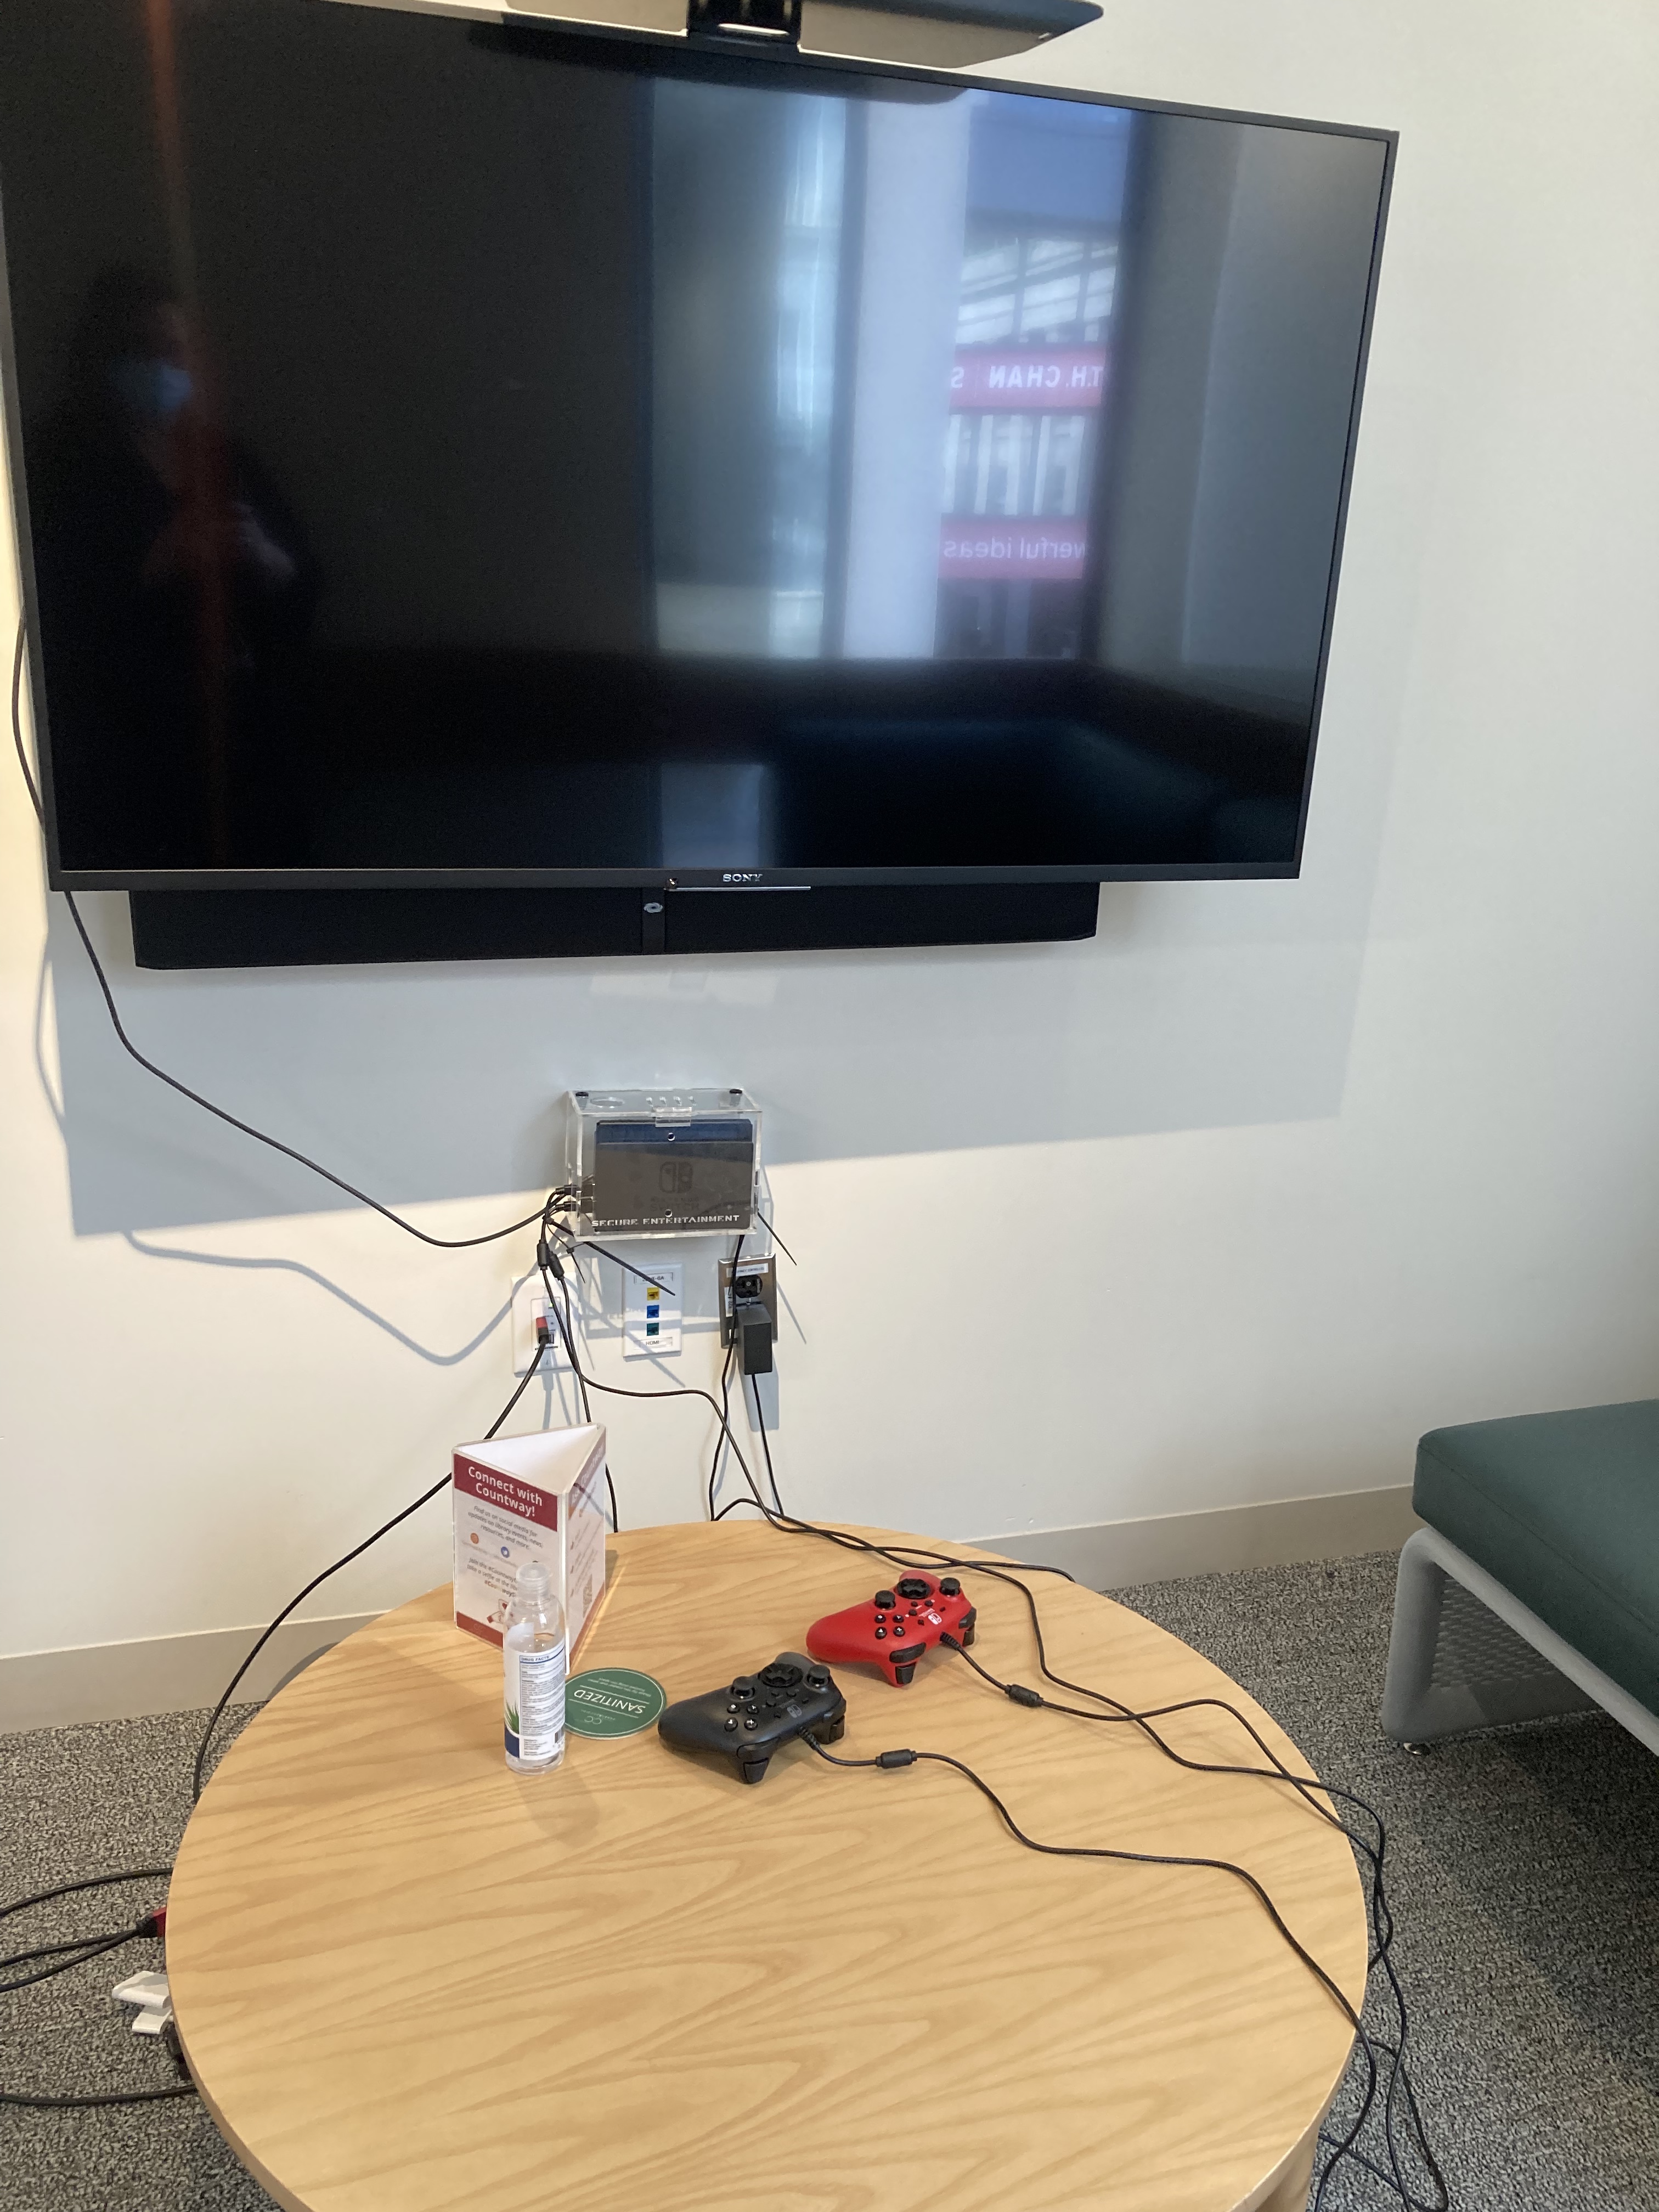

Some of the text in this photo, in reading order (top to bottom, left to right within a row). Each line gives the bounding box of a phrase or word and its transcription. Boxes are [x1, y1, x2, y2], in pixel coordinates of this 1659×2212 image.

[722, 873, 763, 882] SONY
[591, 1215, 740, 1227] SECURE ENTERTAINMENT
[468, 1466, 542, 1506] Connect with
[476, 1482, 535, 1517] Countway!
[468, 1511, 488, 1523] updates
[495, 1522, 512, 1535] library
[512, 1531, 528, 1542] events,
[474, 1505, 484, 1514] Find
[499, 1515, 513, 1527] social
[514, 1523, 529, 1534] media
[529, 1528, 538, 1537] for
[480, 1524, 504, 1539] resources,
[467, 1564, 477, 1572] take
[482, 1571, 494, 1580] selfie
[574, 1689, 646, 1714] SANITIZED
